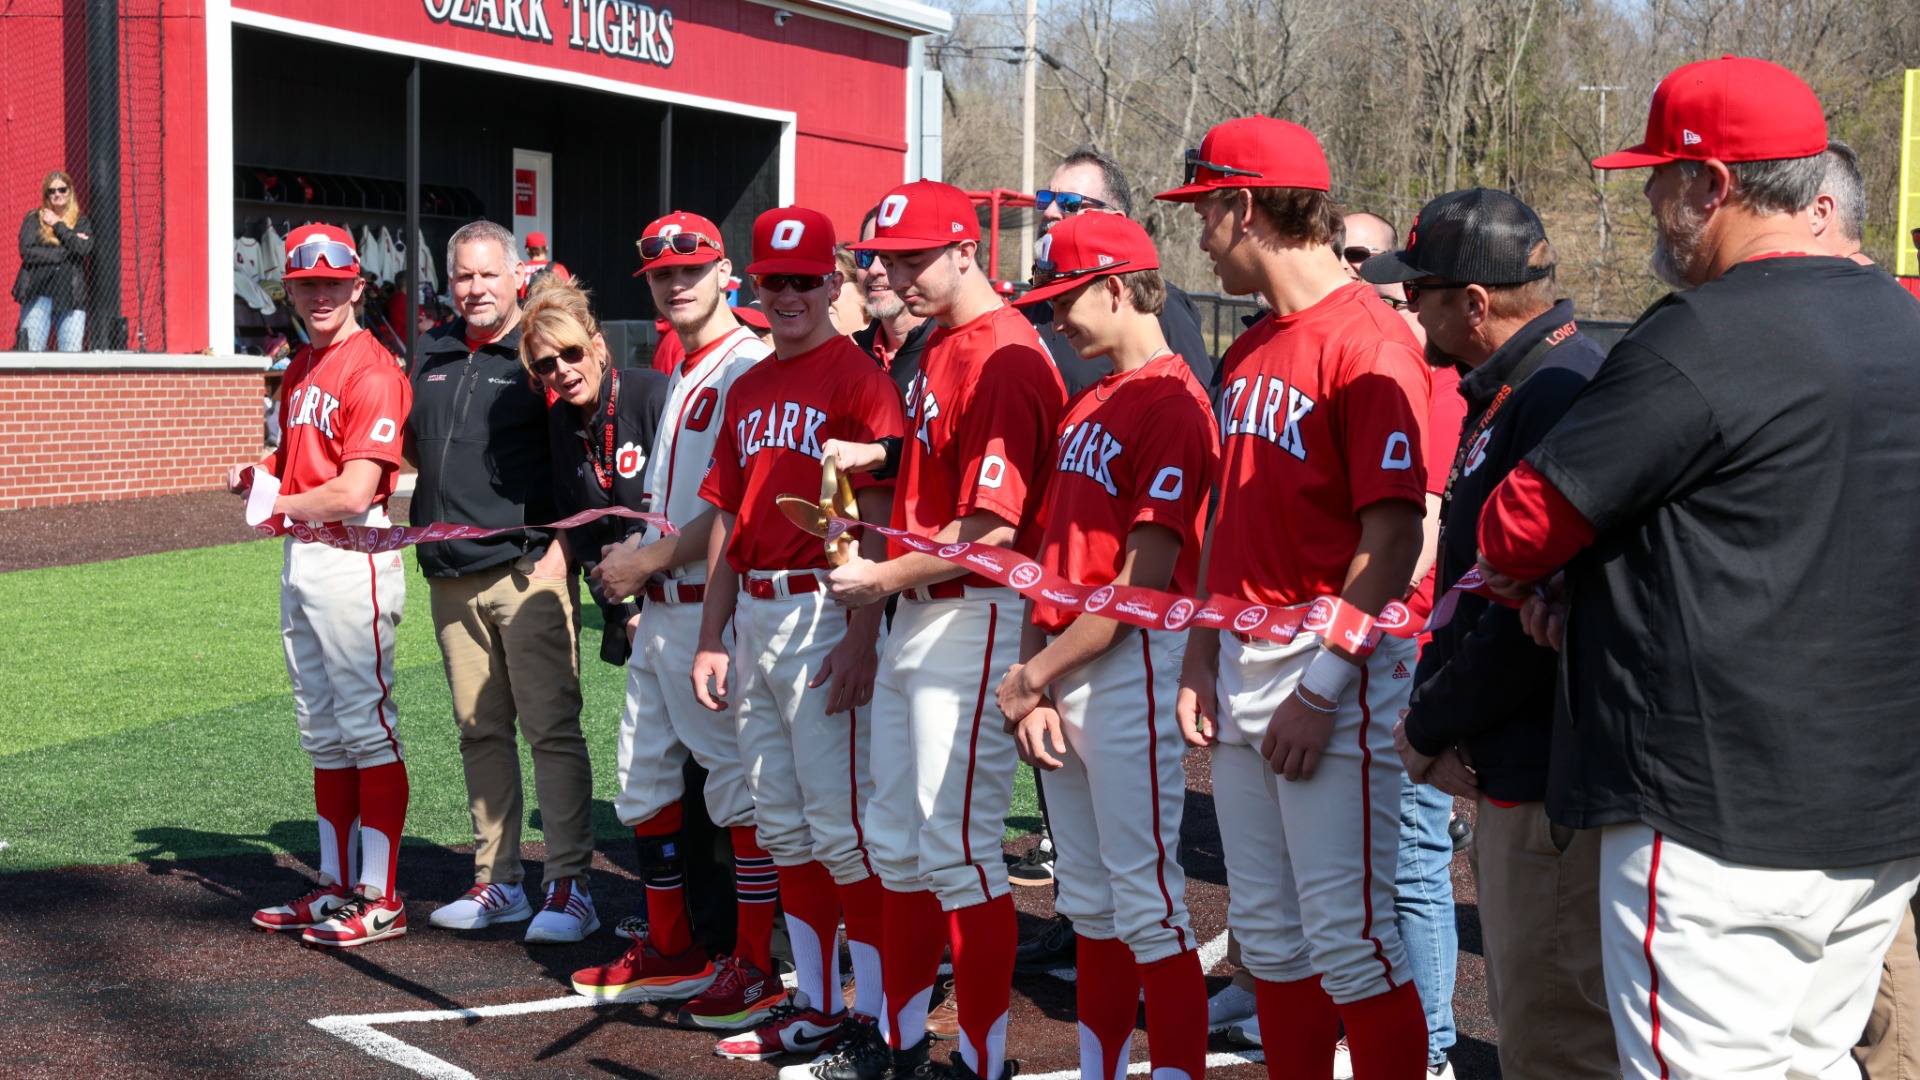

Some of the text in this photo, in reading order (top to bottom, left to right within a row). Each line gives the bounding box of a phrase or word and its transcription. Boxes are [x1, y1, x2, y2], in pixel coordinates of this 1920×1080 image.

[563, 0, 674, 66] TIGERS
[877, 194, 908, 228] O
[771, 219, 806, 250] O
[685, 386, 719, 432] O
[1221, 374, 1315, 464] OZARK
[1480, 384, 1512, 430] TIGERS
[370, 417, 396, 443] O
[605, 424, 614, 455] TIGERS
[737, 400, 828, 468] OZARK
[619, 450, 638, 474] O
[1057, 421, 1123, 497] ZARK
[1381, 430, 1412, 471] O
[979, 454, 1006, 489] O
[1148, 465, 1183, 501] O
